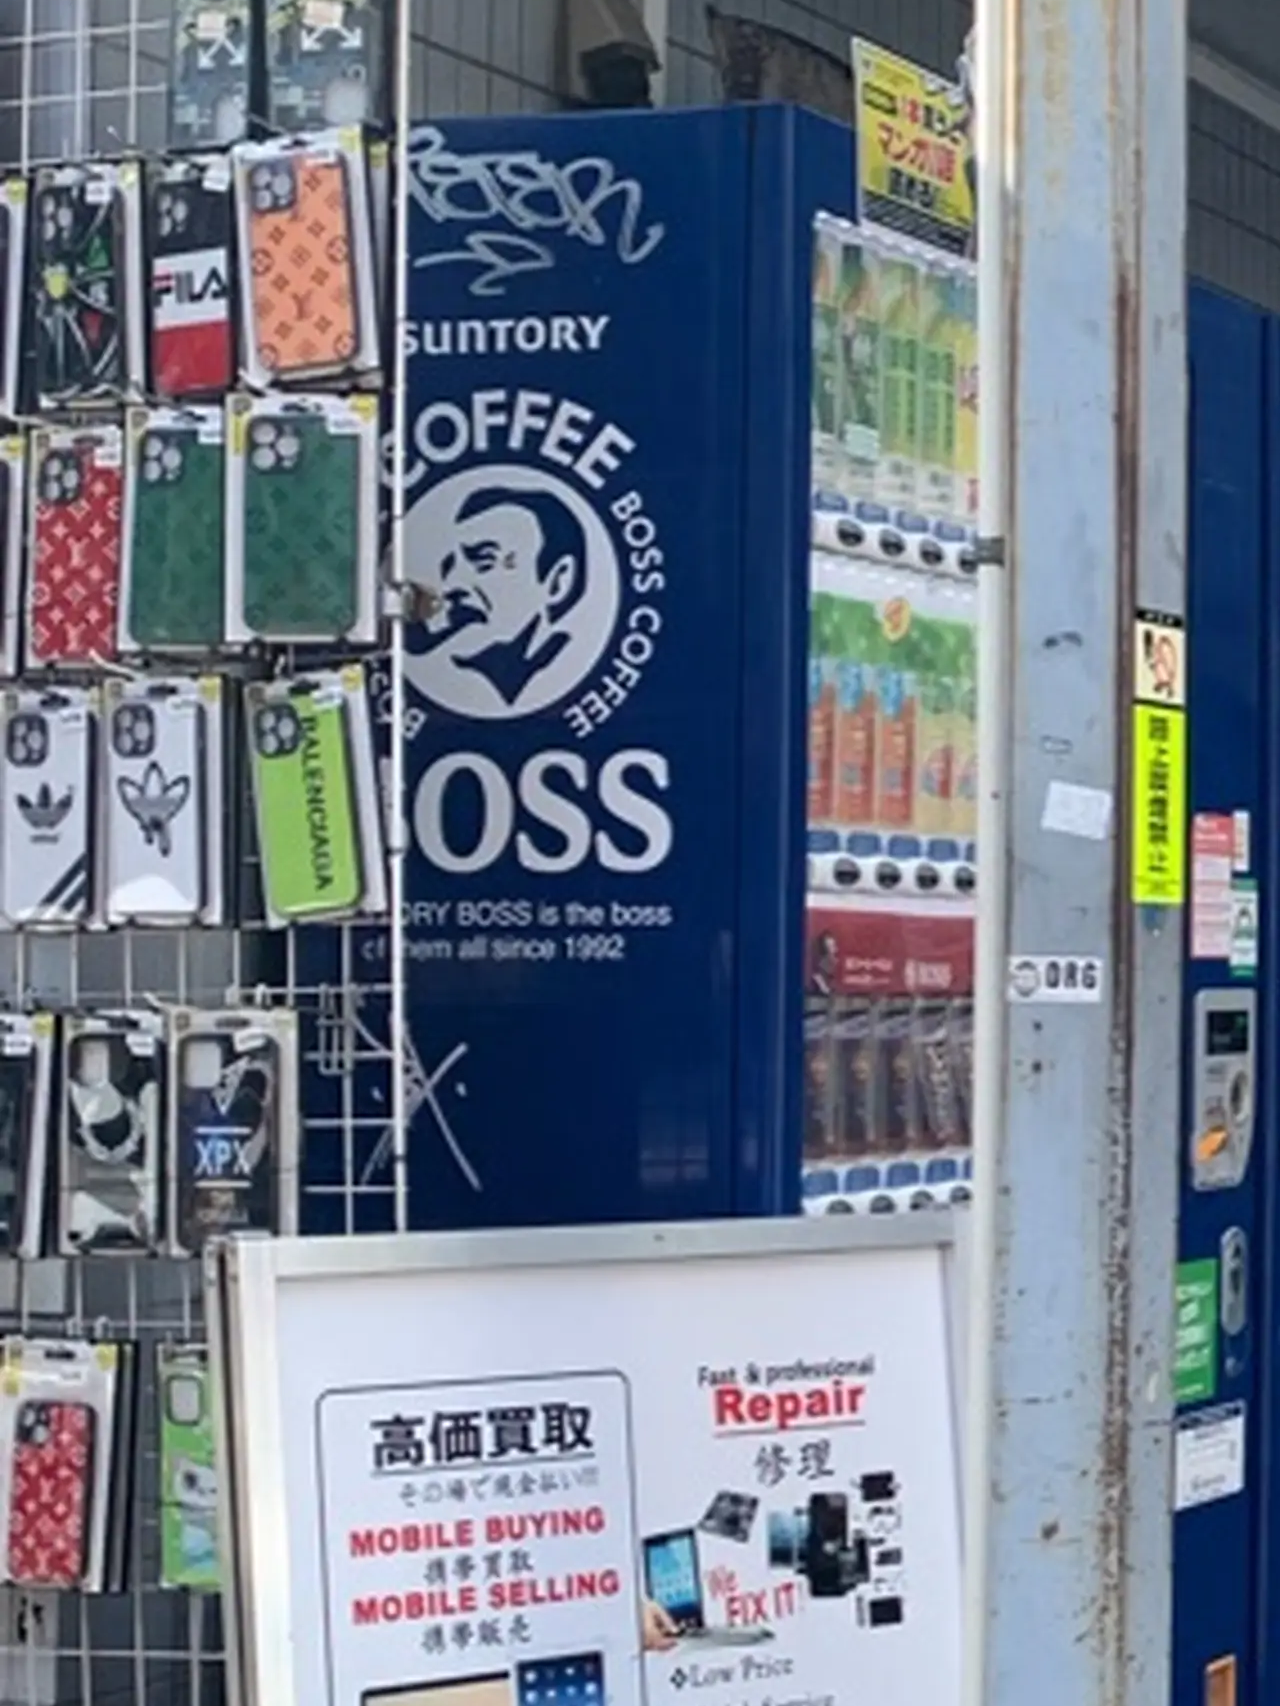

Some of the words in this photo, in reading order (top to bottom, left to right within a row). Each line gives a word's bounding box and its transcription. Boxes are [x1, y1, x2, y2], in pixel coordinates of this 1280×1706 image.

[154, 267, 228, 309] FILA
[382, 390, 635, 489] COFFEE
[611, 491, 665, 593] BOSS
[564, 611, 663, 738] COFFEE
[379, 750, 674, 874] OSS
[457, 901, 533, 927] BOSS
[538, 901, 559, 927] is
[565, 901, 605, 927] the
[611, 900, 674, 927] boss
[458, 936, 486, 960] all
[491, 936, 556, 961] since
[564, 933, 626, 961] 1992
[714, 1380, 866, 1430] Repair
[370, 1402, 594, 1469] 高価買取
[754, 1439, 835, 1487] 修理
[349, 1517, 475, 1558] MOBILE
[486, 1505, 606, 1545] BUYING
[352, 1586, 478, 1626] MOBILE
[488, 1569, 620, 1610] SELLING
[725, 1594, 767, 1627] FIX
[774, 1582, 796, 1619] IT
[689, 1662, 736, 1688] Low
[741, 1656, 794, 1681] Price
